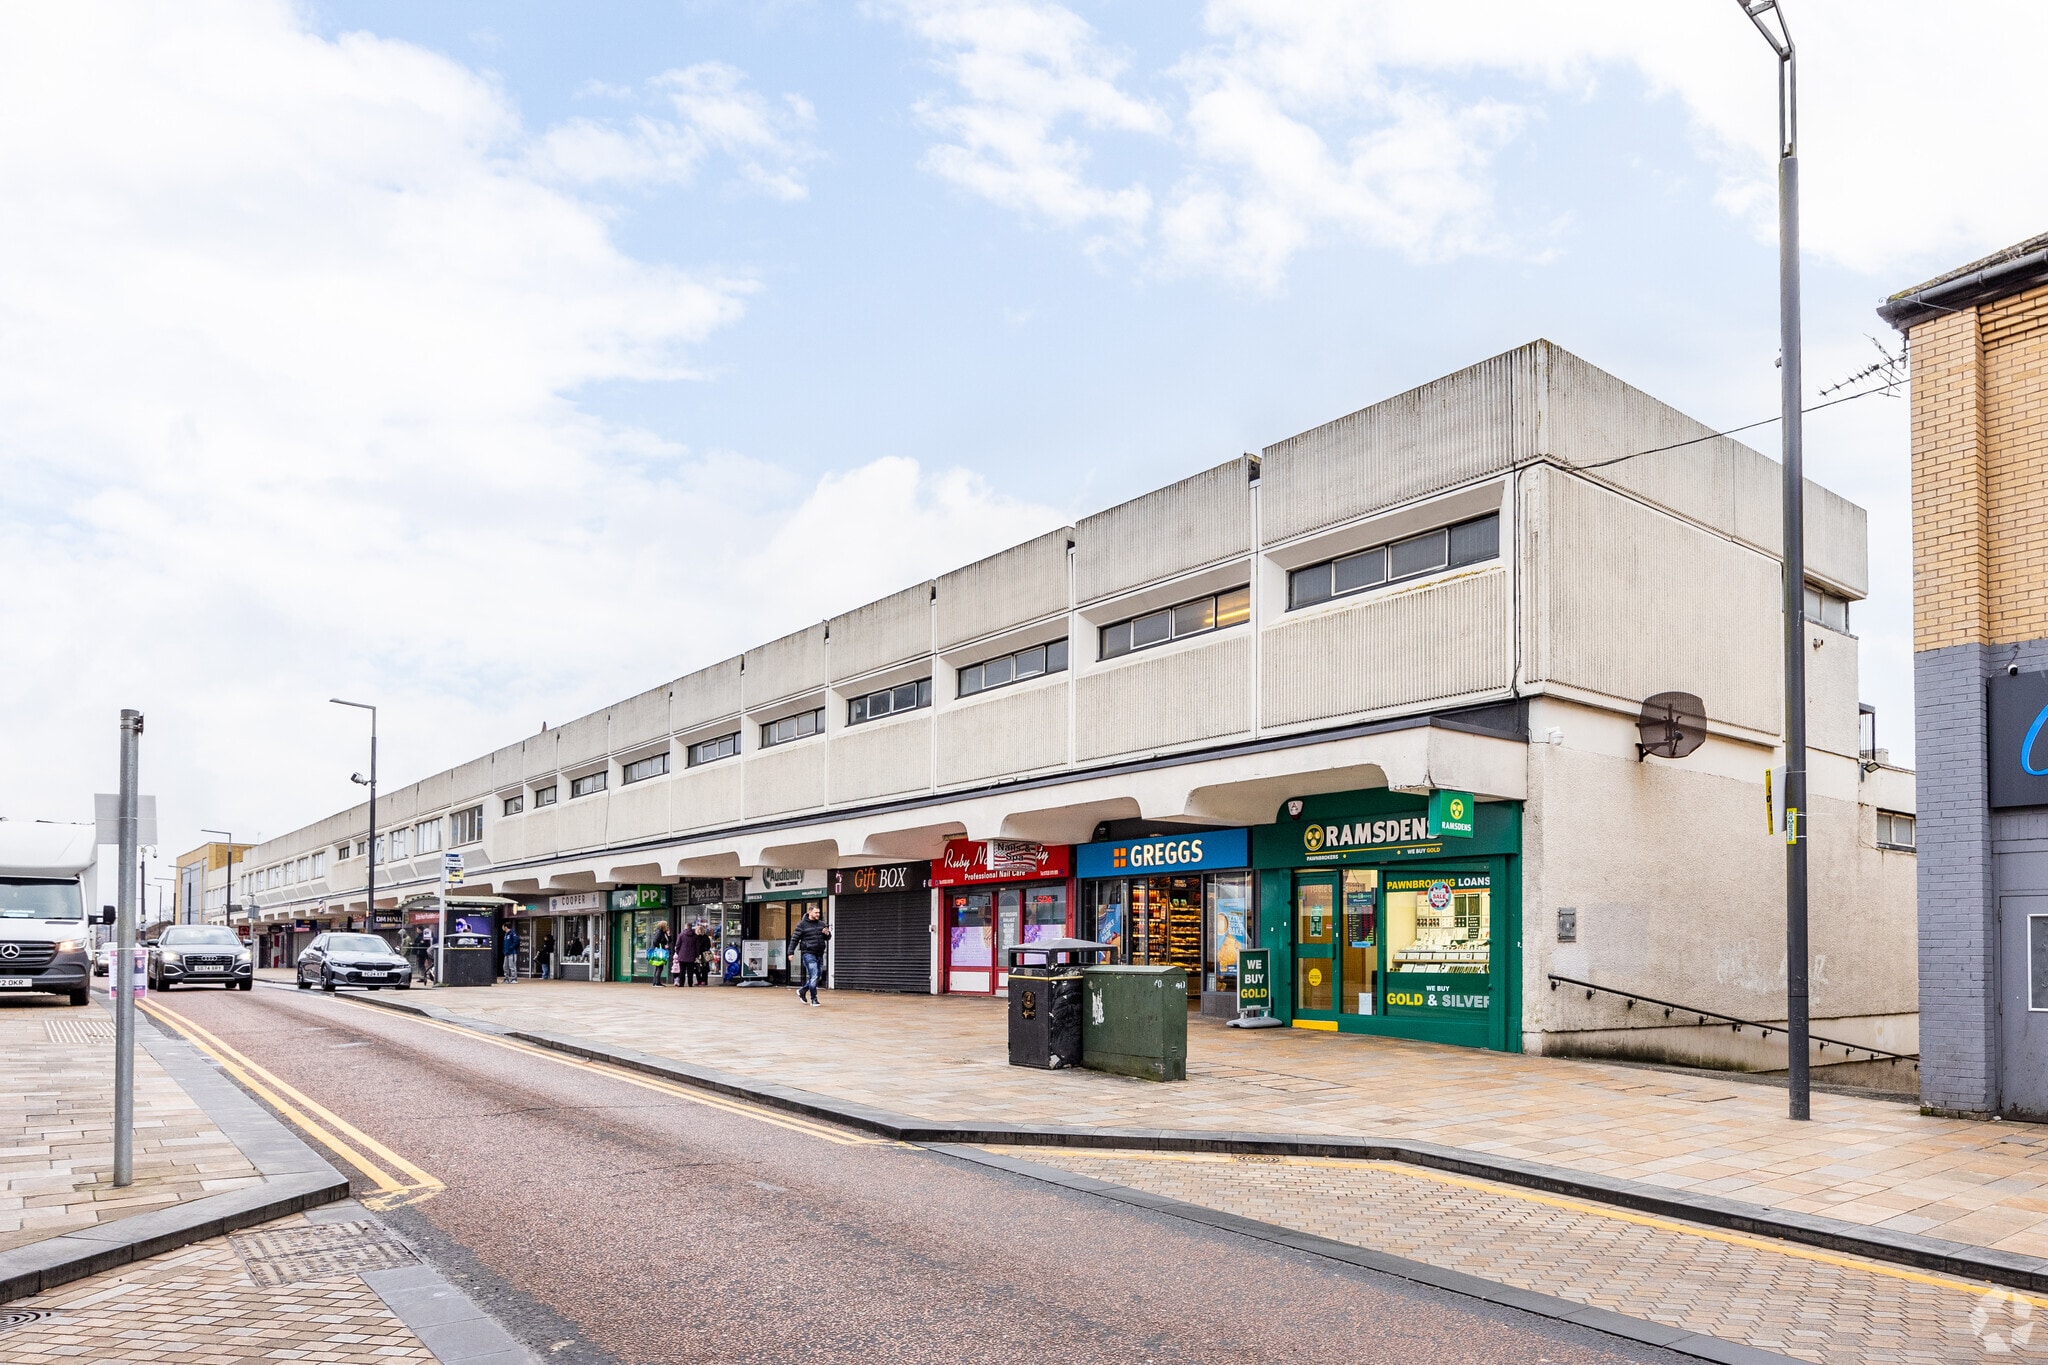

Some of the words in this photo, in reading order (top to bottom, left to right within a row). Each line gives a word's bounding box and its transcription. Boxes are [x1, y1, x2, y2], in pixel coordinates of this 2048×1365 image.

[1441, 821, 1472, 832] RAMSDENS
[1130, 839, 1204, 867] GREGGS
[944, 848, 970, 872] Ruby
[769, 868, 805, 884] Audibility
[854, 866, 877, 893] Gift
[878, 867, 907, 888] BOX
[964, 871, 998, 881] Professional
[999, 870, 1011, 878] Nail
[1386, 878, 1456, 890] PAWNBRONG
[1457, 877, 1490, 887] LOANS
[561, 894, 586, 906] COOPER
[641, 889, 658, 903] PP
[1246, 960, 1262, 970] WE
[1244, 974, 1264, 984] BUY
[1240, 988, 1268, 999] GOLD
[1386, 992, 1424, 1006] GOLD
[1427, 993, 1438, 1006] &
